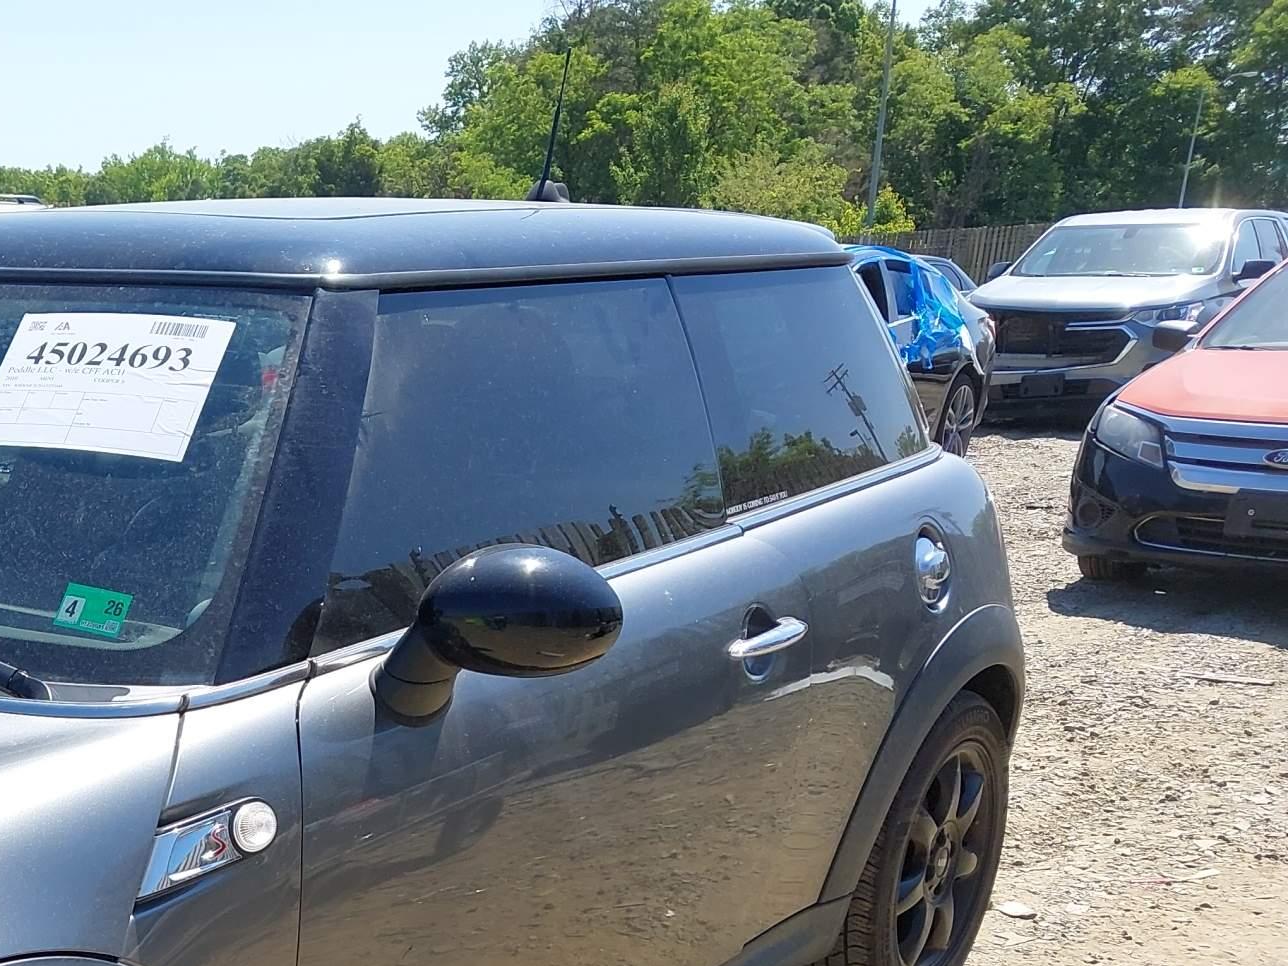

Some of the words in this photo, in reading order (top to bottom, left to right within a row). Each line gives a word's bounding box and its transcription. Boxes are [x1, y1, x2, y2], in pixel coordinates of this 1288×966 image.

[26, 341, 193, 372] 45024693
[8, 365, 35, 374] Peddle
[37, 366, 55, 374] LLC
[65, 599, 79, 618] 4
[104, 599, 124, 617] 26
